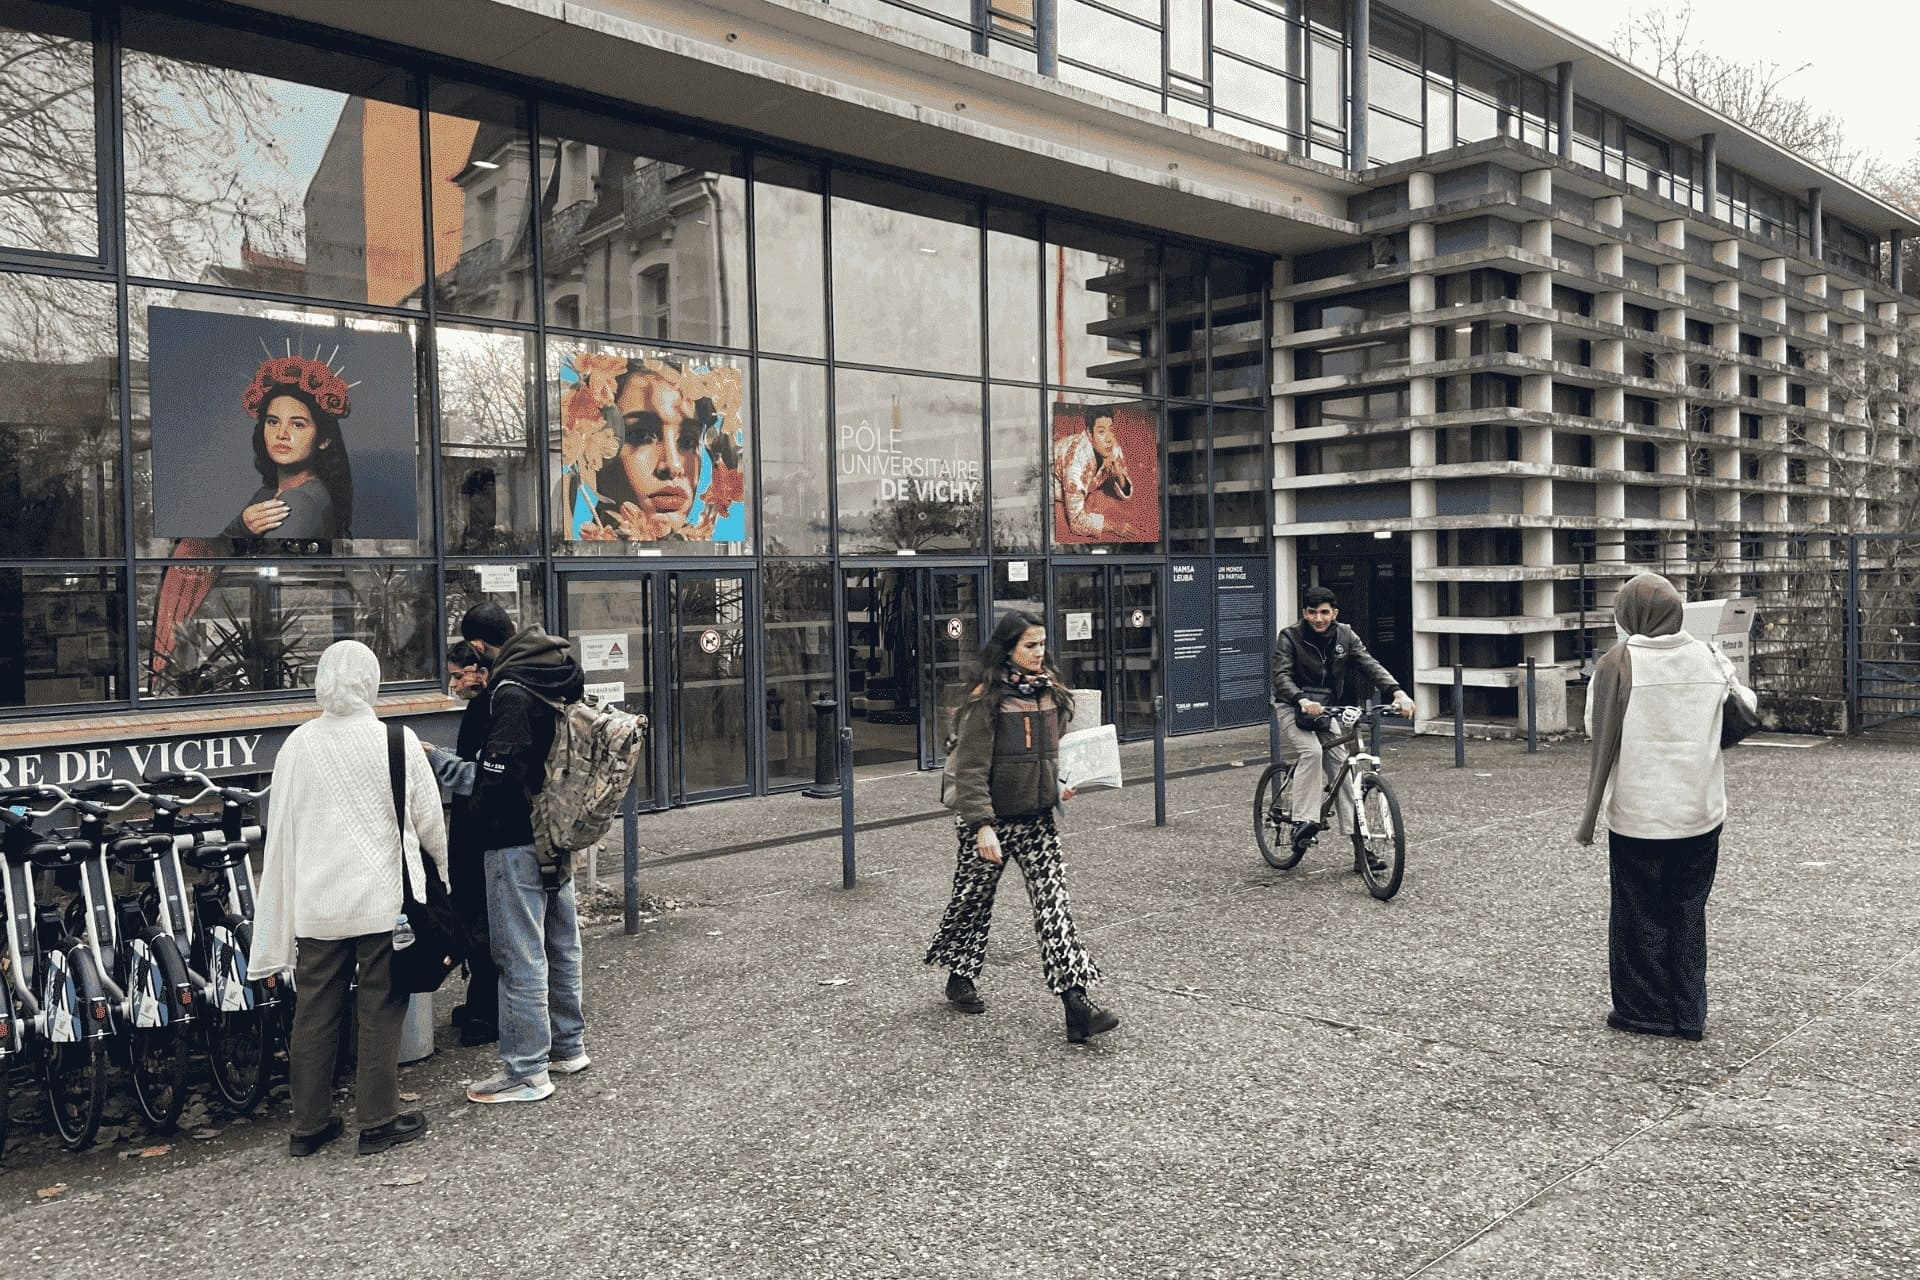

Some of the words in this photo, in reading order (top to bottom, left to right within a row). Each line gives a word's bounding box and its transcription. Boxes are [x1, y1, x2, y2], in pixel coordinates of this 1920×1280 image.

[841, 420, 903, 453] PÔLE
[842, 454, 981, 480] UNIVERSITAIRE
[880, 478, 910, 501] DE
[914, 480, 977, 503] VICHY
[56, 749, 113, 785] DE
[126, 735, 262, 777] VICHY
